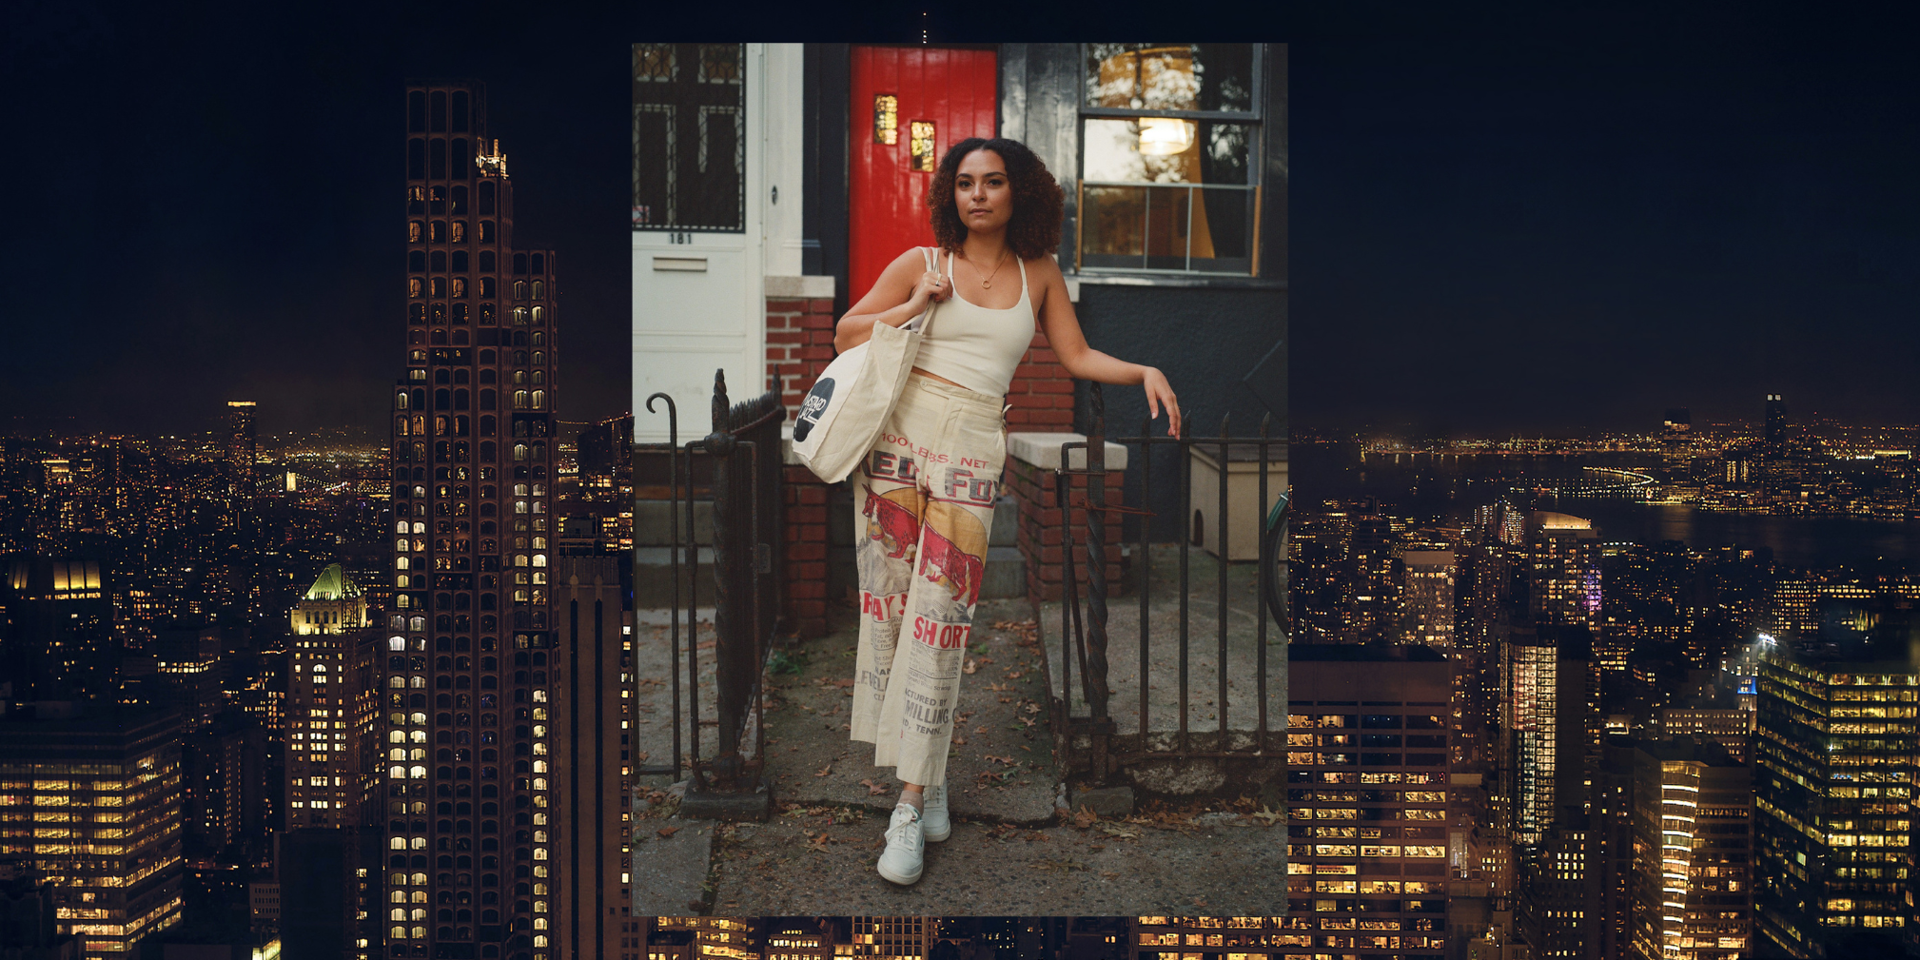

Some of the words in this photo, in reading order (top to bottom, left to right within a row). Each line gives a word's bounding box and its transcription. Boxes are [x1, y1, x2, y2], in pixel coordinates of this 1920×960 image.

[669, 232, 692, 245] 181
[881, 432, 908, 447] 100
[960, 457, 989, 469] NET
[939, 698, 948, 706] BY
[905, 699, 949, 725] MILLING
[915, 724, 942, 736] TENN.
